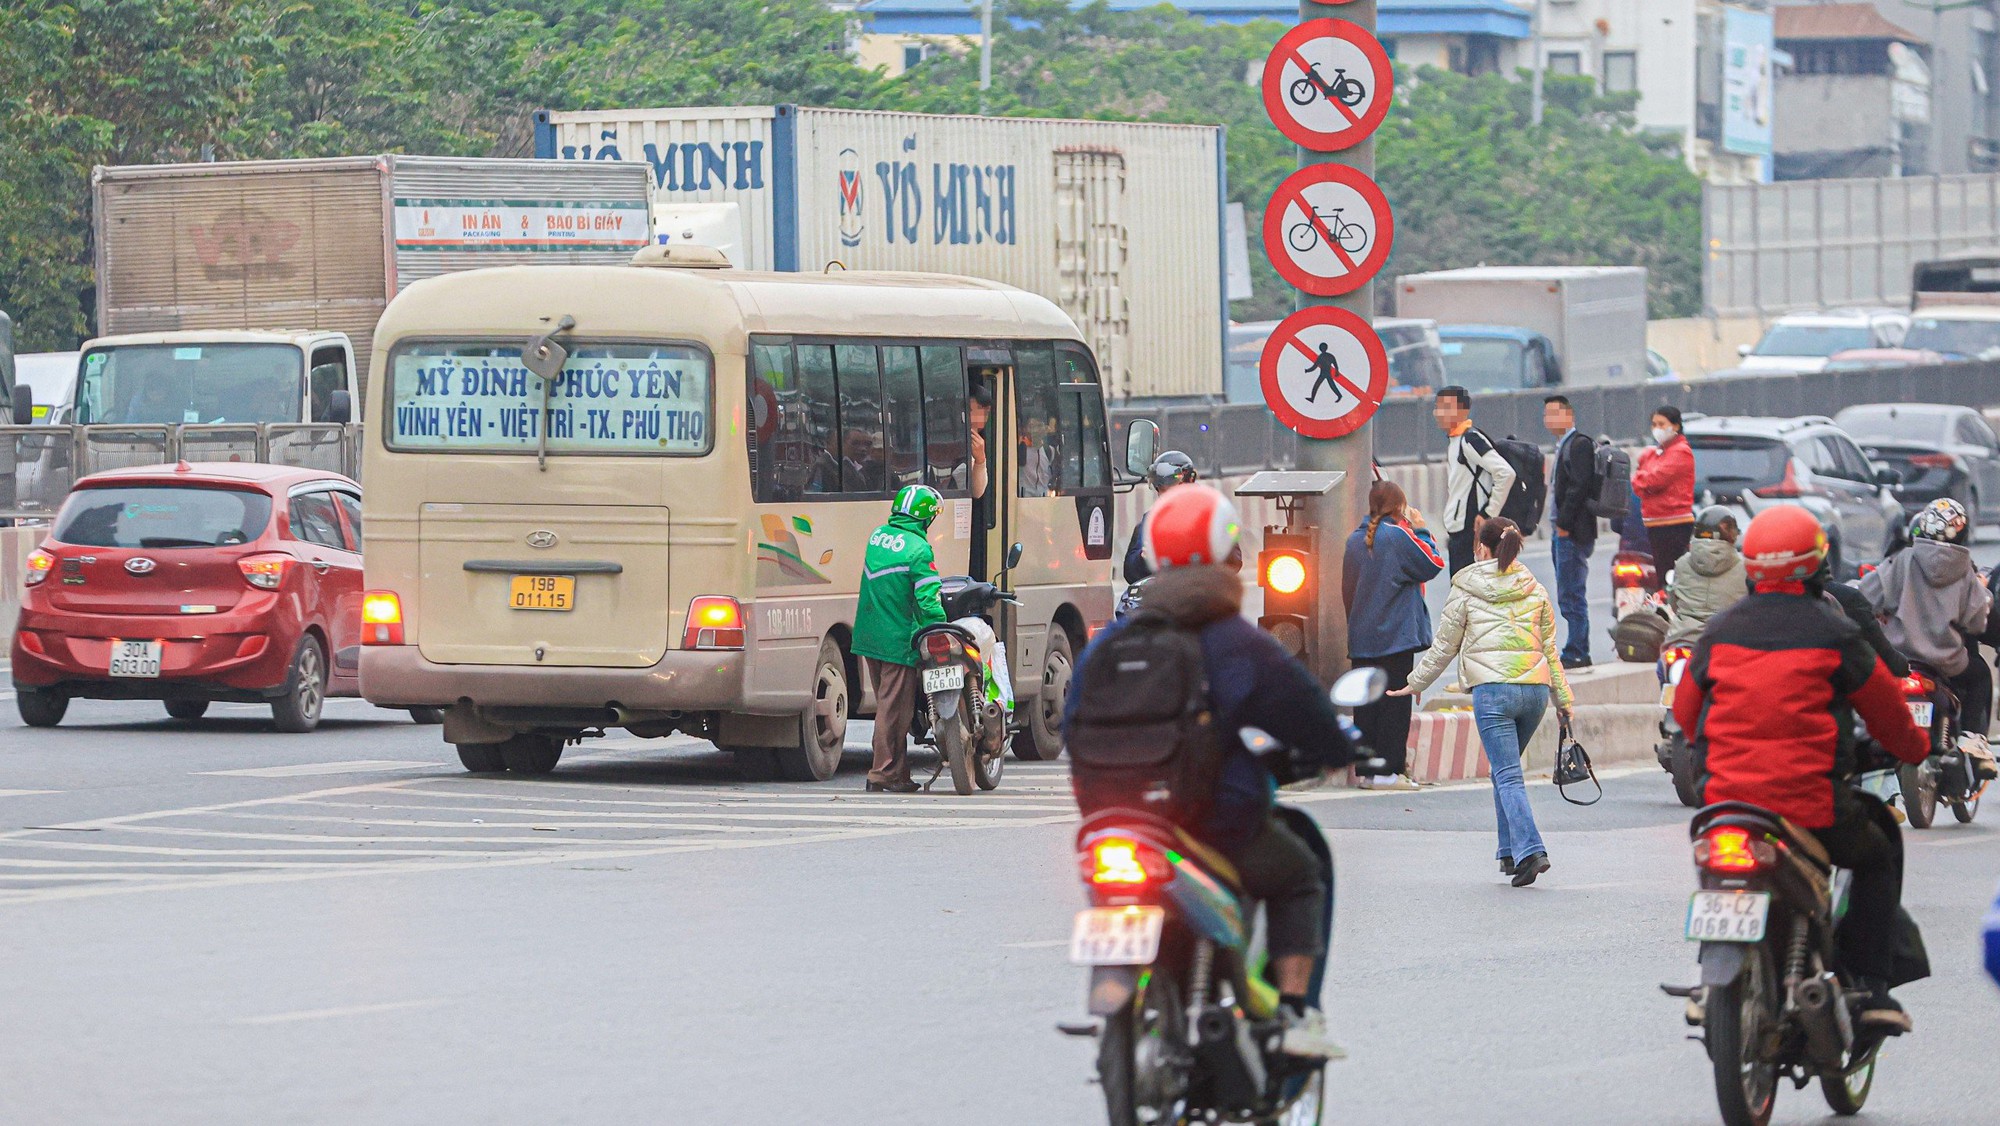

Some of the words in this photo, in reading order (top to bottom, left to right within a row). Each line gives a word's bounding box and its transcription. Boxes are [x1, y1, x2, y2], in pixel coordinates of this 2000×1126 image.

[643, 140, 764, 191] MINH
[933, 162, 1016, 245] MINH
[462, 214, 477, 229] IN
[521, 214, 529, 229] &
[547, 214, 573, 230] BAO
[576, 212, 590, 230] BÌ
[594, 210, 622, 230] GIẤY
[415, 359, 455, 396] MỸ
[461, 360, 528, 397] ĐÌNH
[550, 362, 620, 398] PHÚC
[627, 361, 683, 399] YÊN
[397, 401, 440, 436] VĨNH
[446, 401, 482, 437] YÊN
[500, 402, 539, 442] VIỆT
[547, 403, 573, 438] TRÌ
[622, 403, 661, 440] PHÚ
[667, 410, 704, 446] THỌ
[869, 529, 906, 552] Grab
[530, 577, 556, 591] 19B
[516, 593, 566, 607] 011.15
[123, 642, 149, 658] 30A
[112, 659, 157, 674] 603.00
[929, 667, 956, 680] 29-P1
[926, 677, 961, 691] 846.00
[1702, 895, 1756, 915] 36-C2
